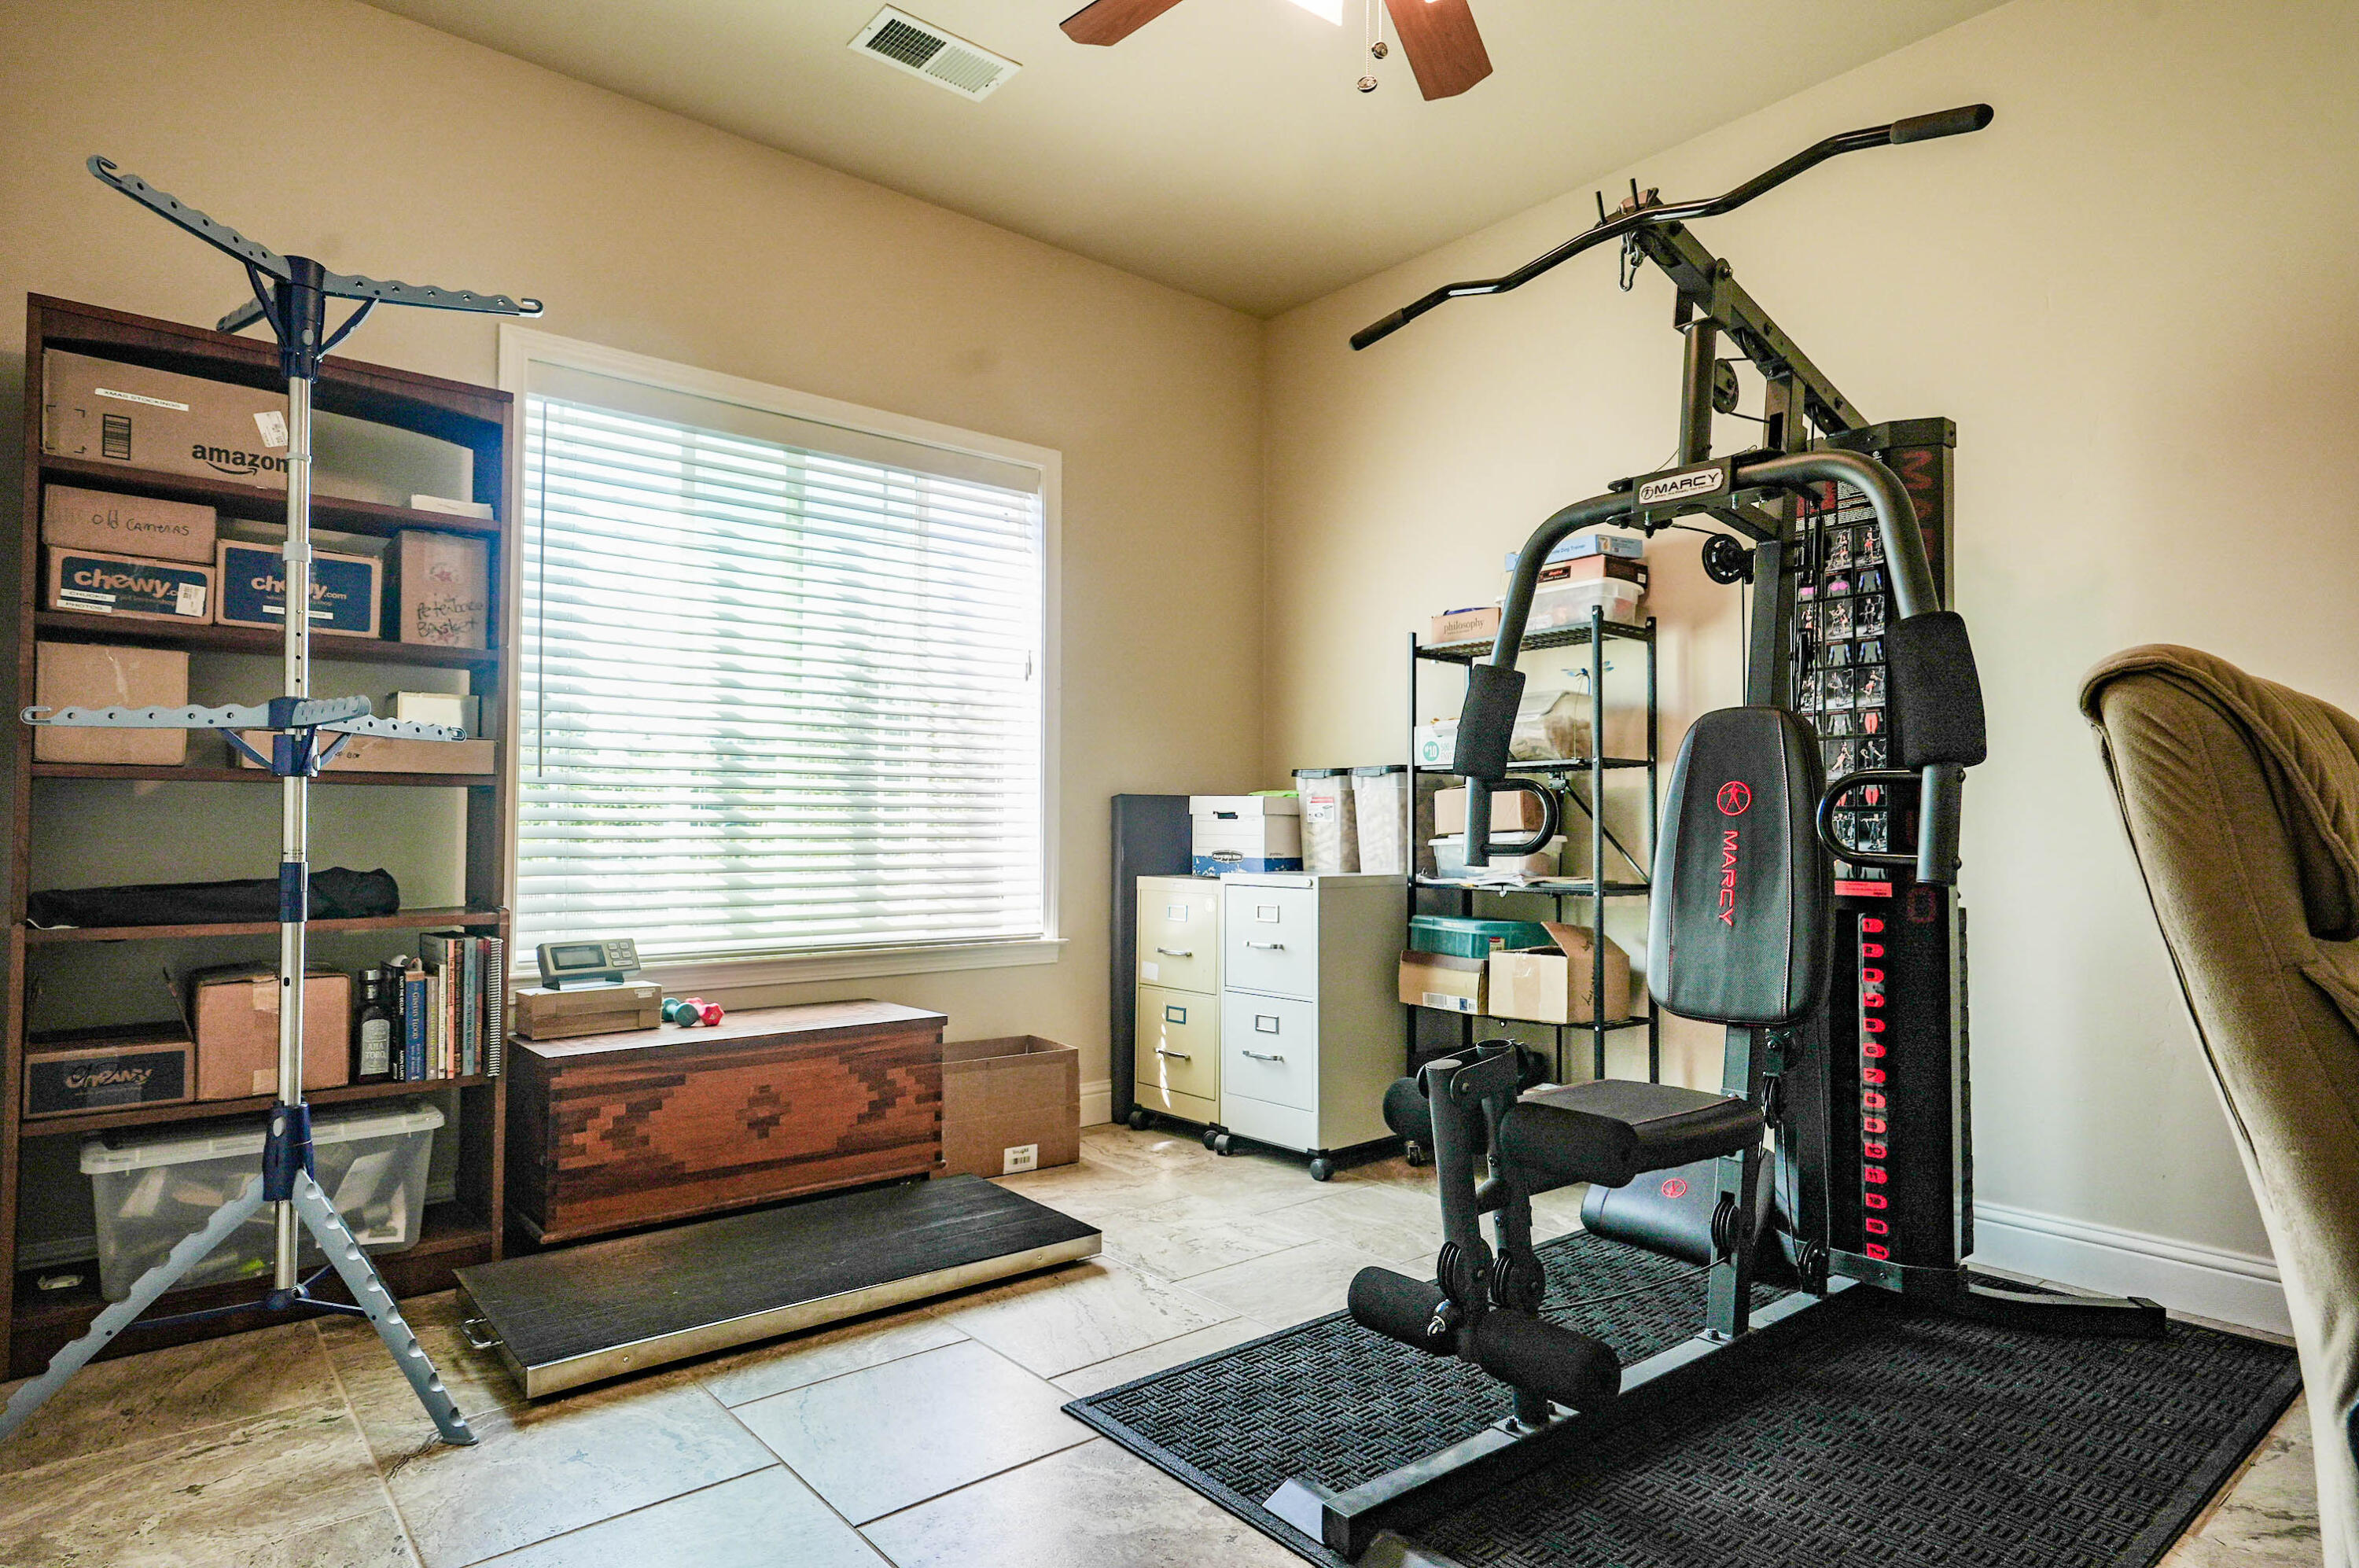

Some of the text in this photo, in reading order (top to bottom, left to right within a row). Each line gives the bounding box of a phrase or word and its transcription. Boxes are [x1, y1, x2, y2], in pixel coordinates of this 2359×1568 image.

[131, 395, 181, 409] STOCKINGS
[192, 444, 289, 473] amazon
[1654, 472, 1719, 495] MARCY
[74, 569, 178, 598] chewy.c
[251, 575, 347, 599] chy.com
[65, 602, 103, 611] PHOTOS
[68, 591, 107, 600] CHUCKS
[1444, 617, 1485, 635] philosophy
[1718, 830, 1739, 926] MARCY
